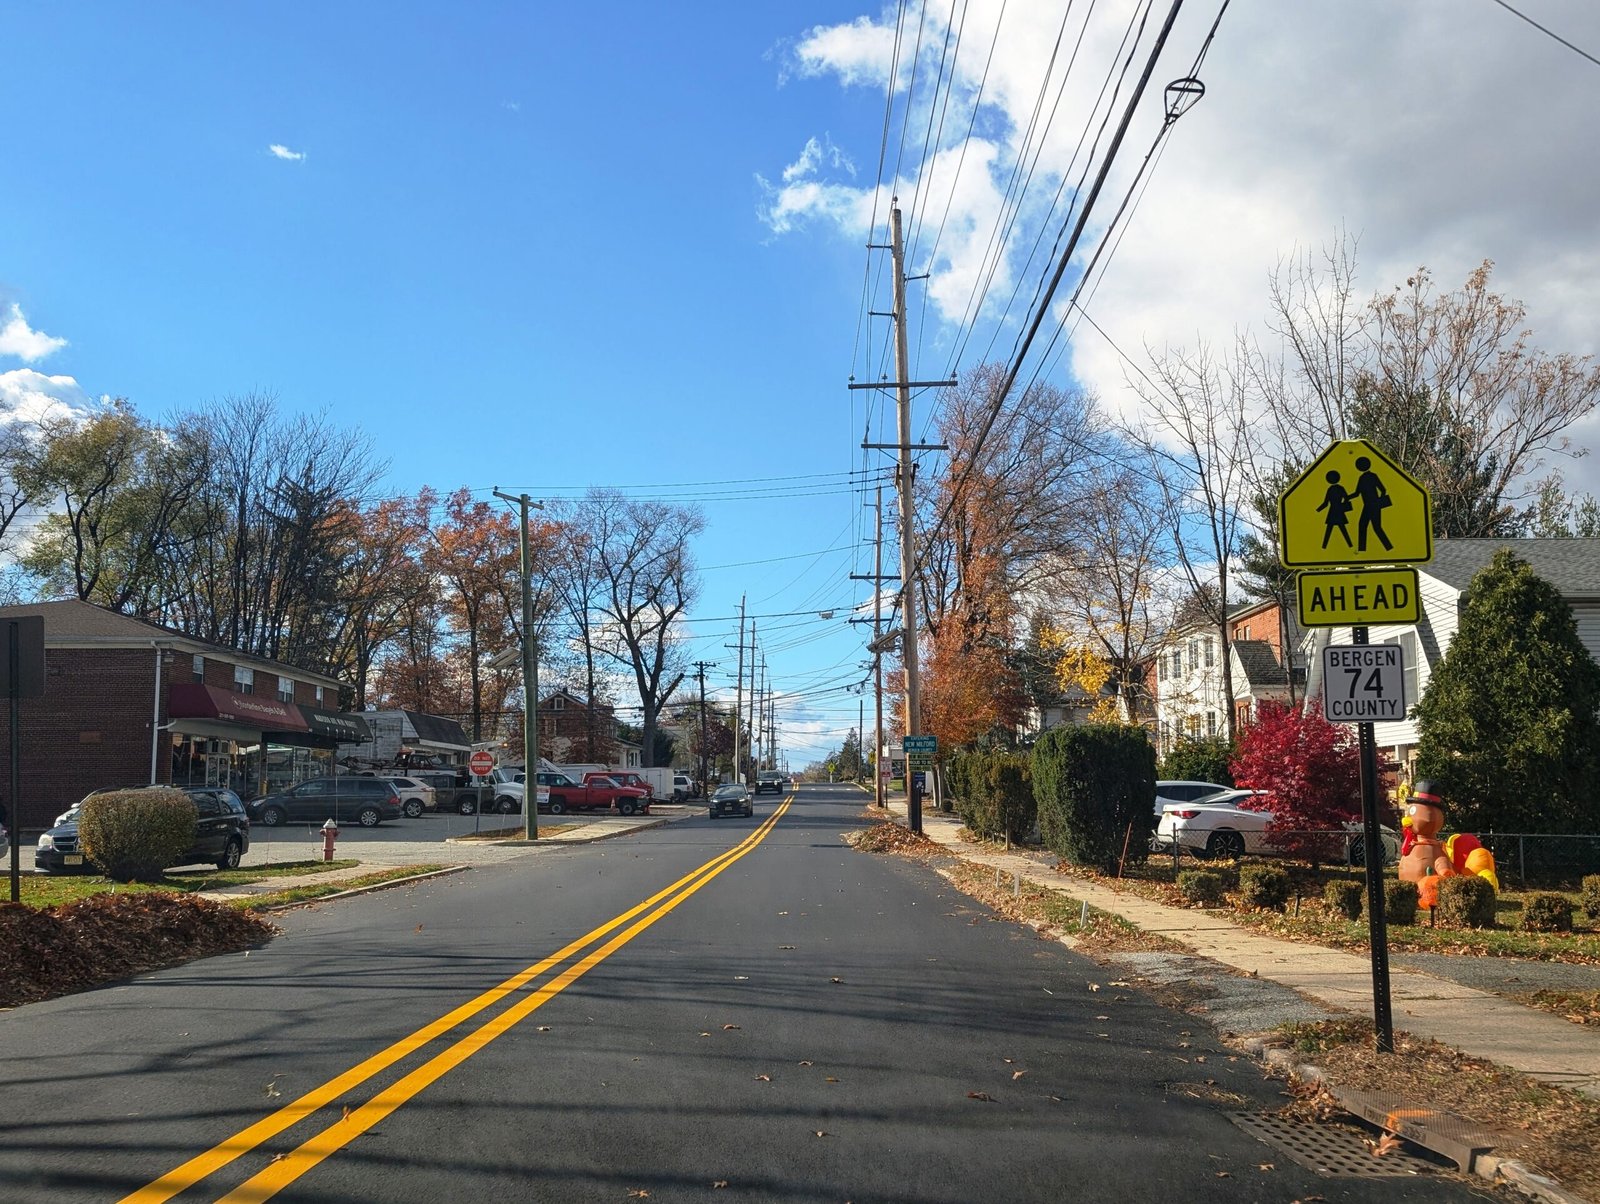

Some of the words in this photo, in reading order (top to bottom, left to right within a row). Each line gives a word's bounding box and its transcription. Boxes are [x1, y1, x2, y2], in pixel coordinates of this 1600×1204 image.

[1310, 583, 1409, 612] AHEAD
[1330, 650, 1396, 667] BERGEN
[1343, 668, 1384, 699] 74
[1332, 699, 1398, 716] COUNTY
